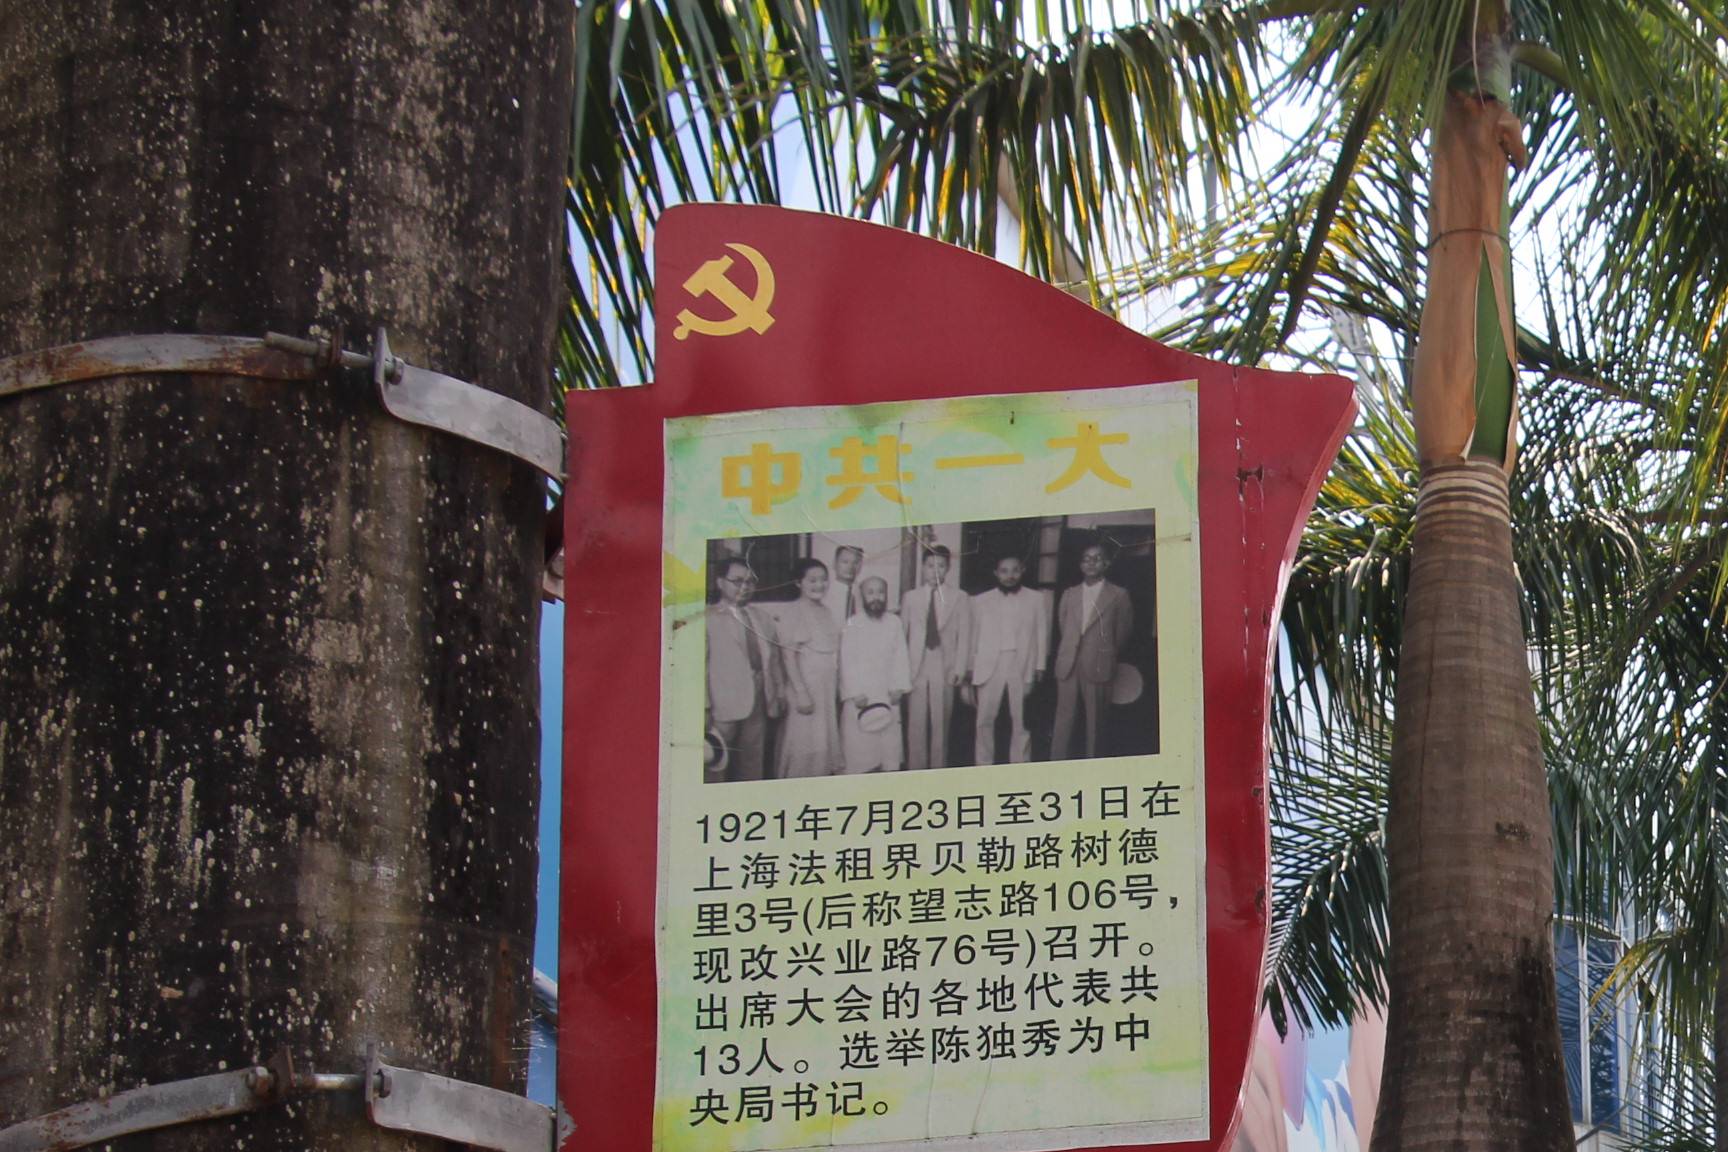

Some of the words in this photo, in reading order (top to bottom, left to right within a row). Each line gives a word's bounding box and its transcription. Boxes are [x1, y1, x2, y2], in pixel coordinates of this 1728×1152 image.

[722, 421, 1133, 516] 中共一大
[696, 780, 1182, 844] 1921年7月23日至31日在
[692, 827, 1160, 892] 上海法租界贝勒路树德
[693, 922, 1160, 984] 现改兴业路76号)召开。
[695, 966, 1160, 1032] 出席大会的各地代表共
[694, 1012, 1151, 1076] 13人。选举陈独秀为中
[689, 1081, 890, 1127] 央局书记。
